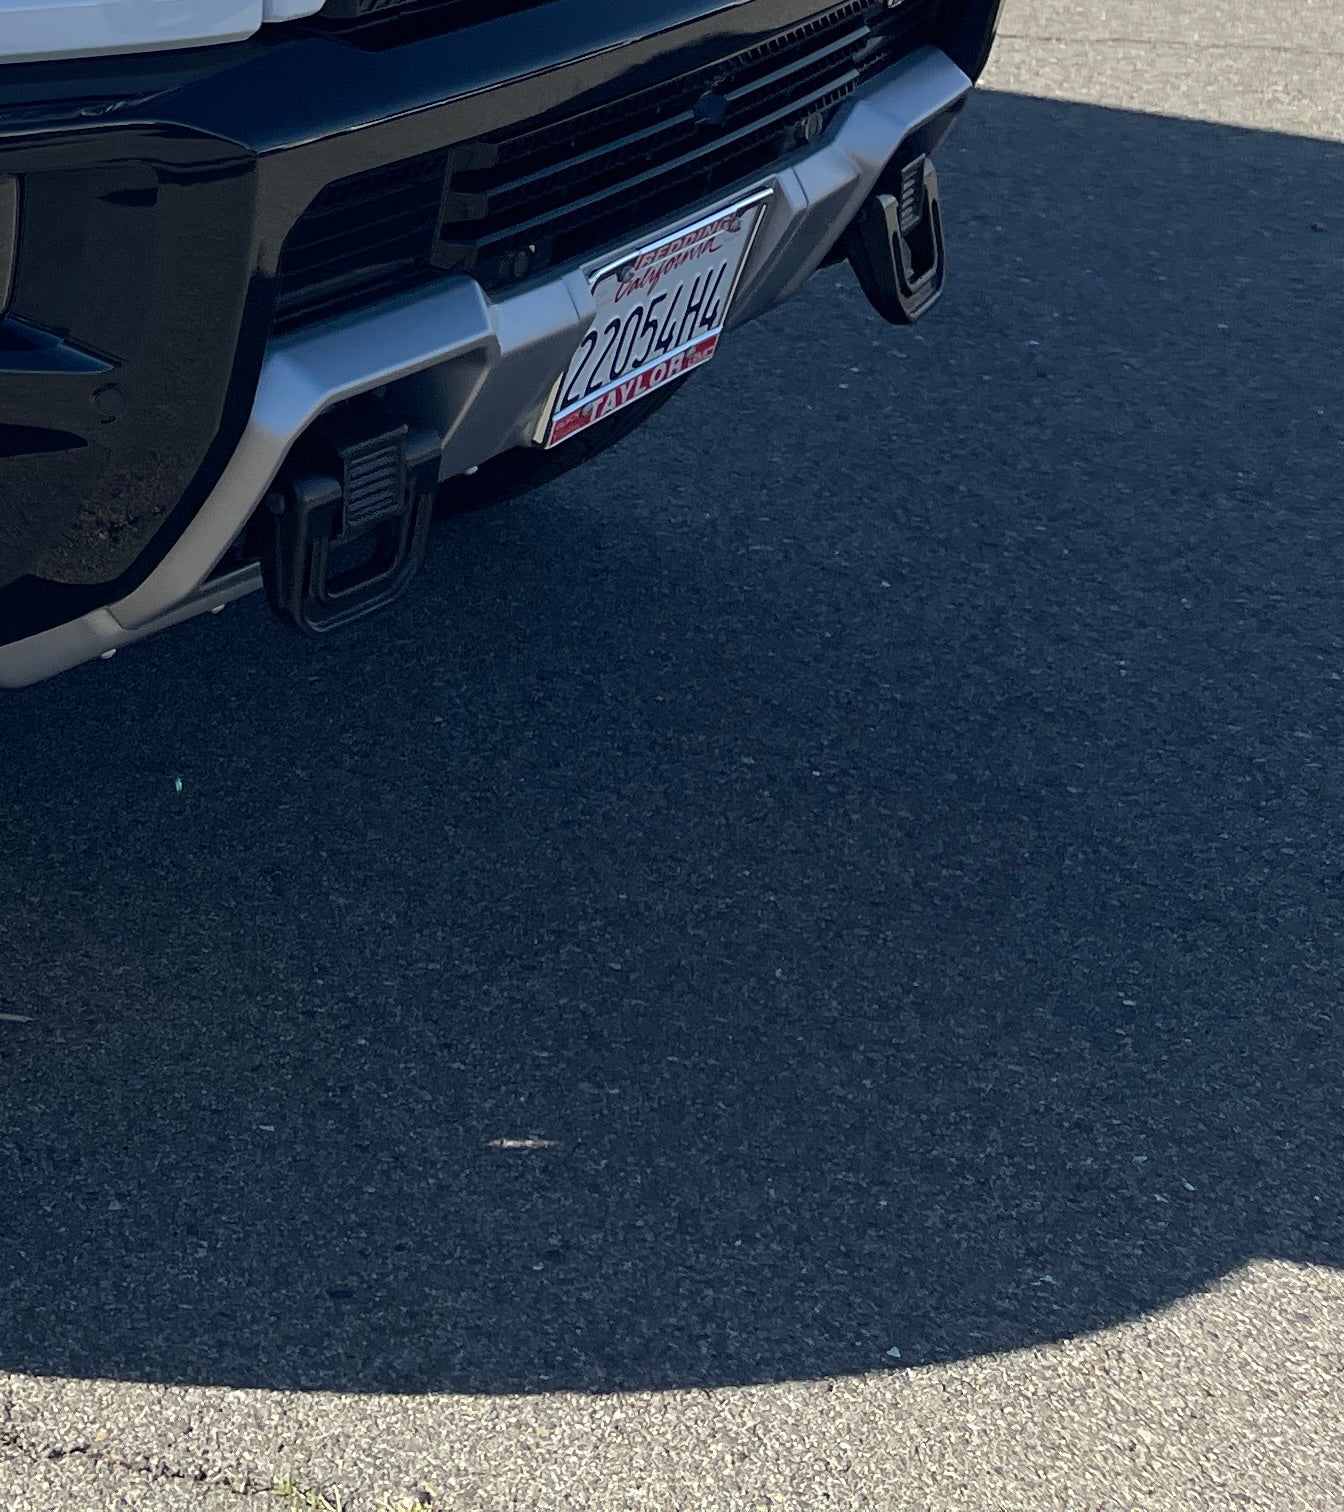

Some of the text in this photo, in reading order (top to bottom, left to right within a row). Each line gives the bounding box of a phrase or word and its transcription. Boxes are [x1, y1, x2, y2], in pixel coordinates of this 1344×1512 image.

[614, 236, 724, 304] California
[561, 261, 728, 407] 22054H4
[589, 350, 687, 423] TAYLOR
